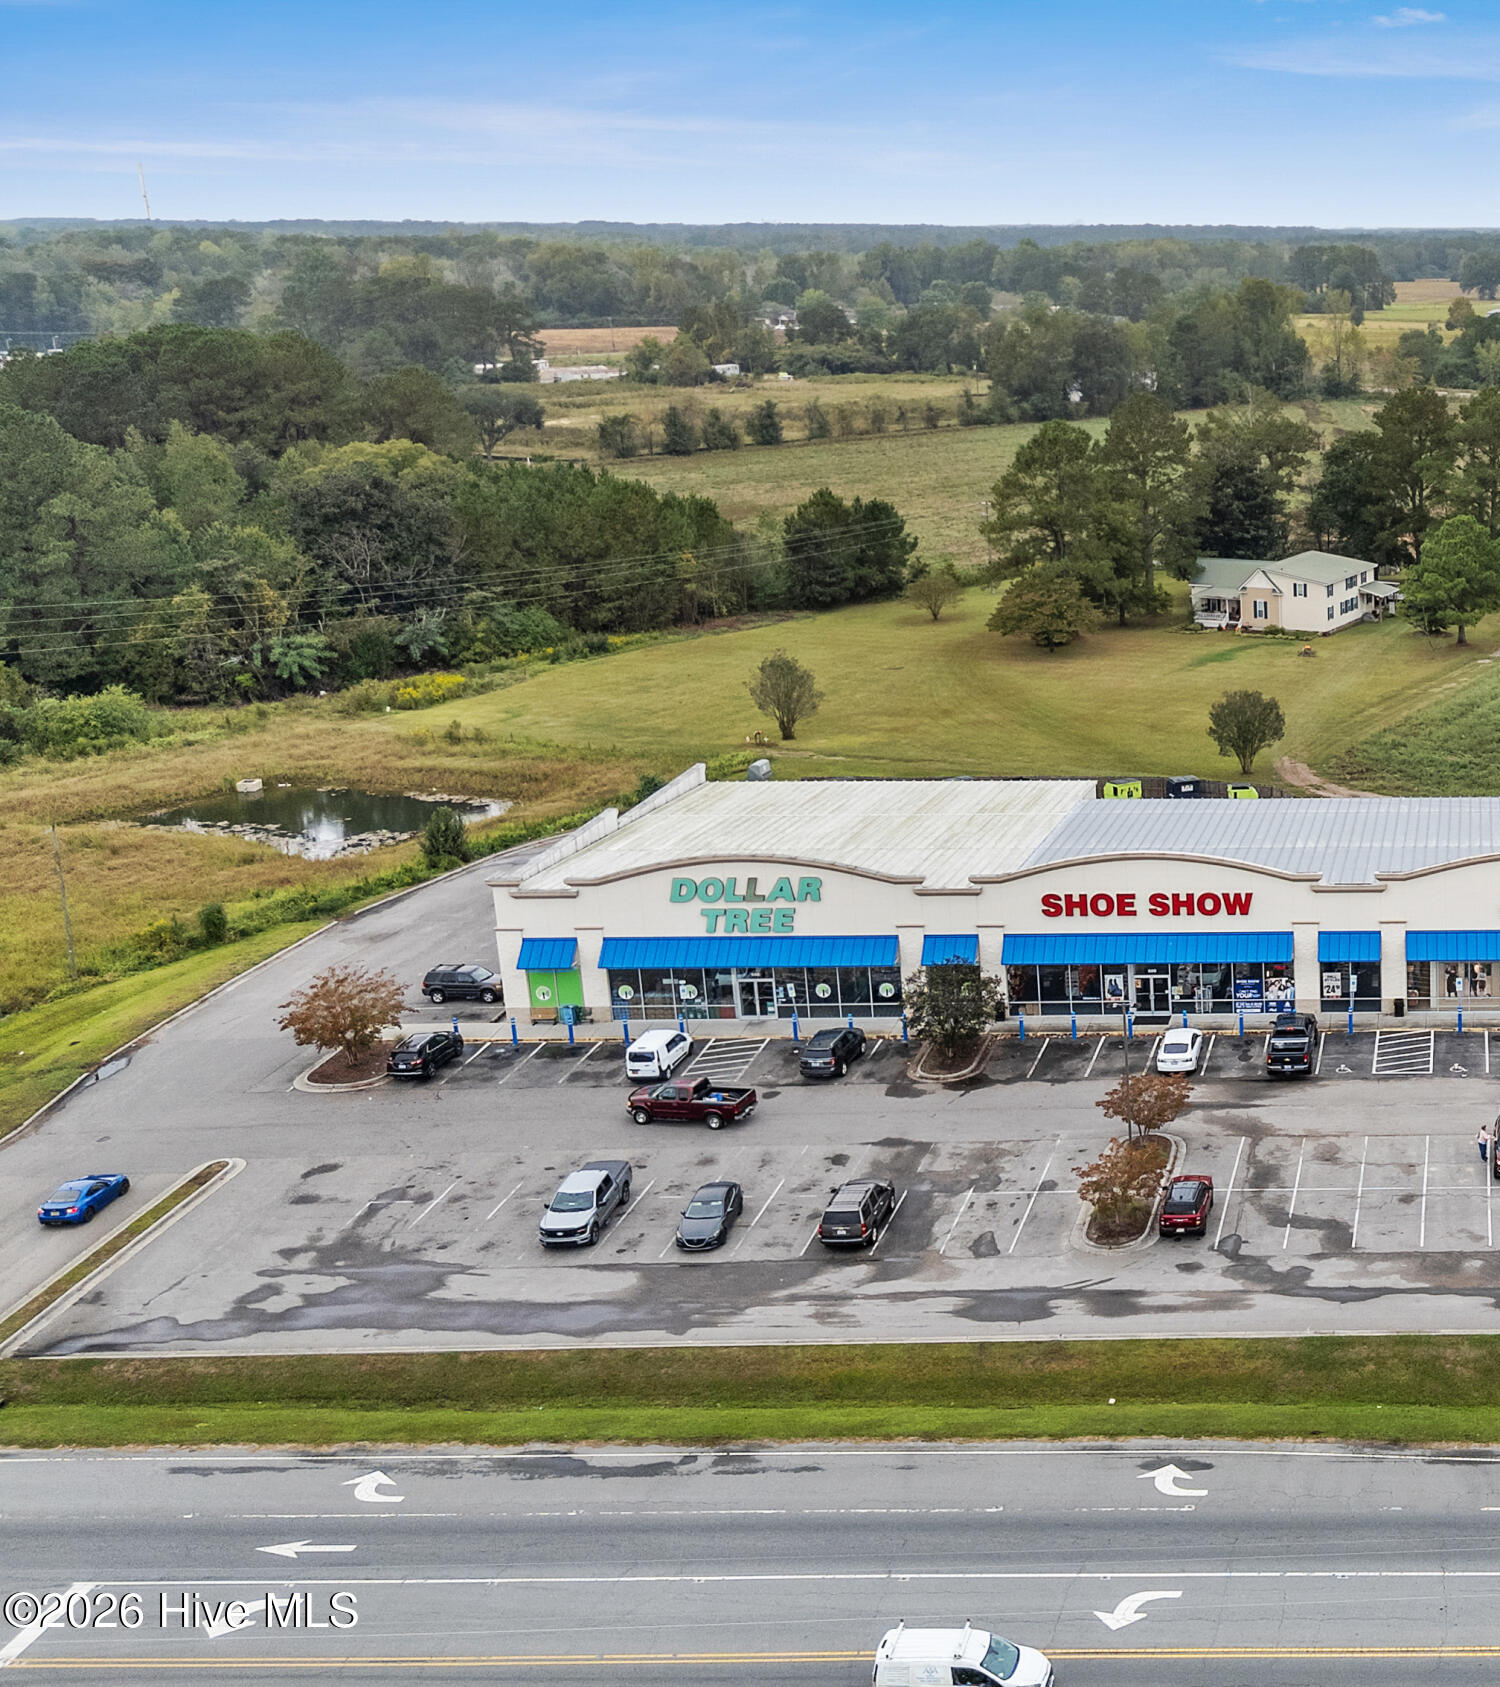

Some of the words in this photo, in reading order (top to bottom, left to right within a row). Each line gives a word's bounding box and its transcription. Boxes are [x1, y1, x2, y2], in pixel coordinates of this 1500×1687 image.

[670, 877, 822, 903] DOLLAR
[1041, 892, 1137, 918] SHOE
[1149, 892, 1253, 917] SHOW
[701, 908, 796, 934] TREE
